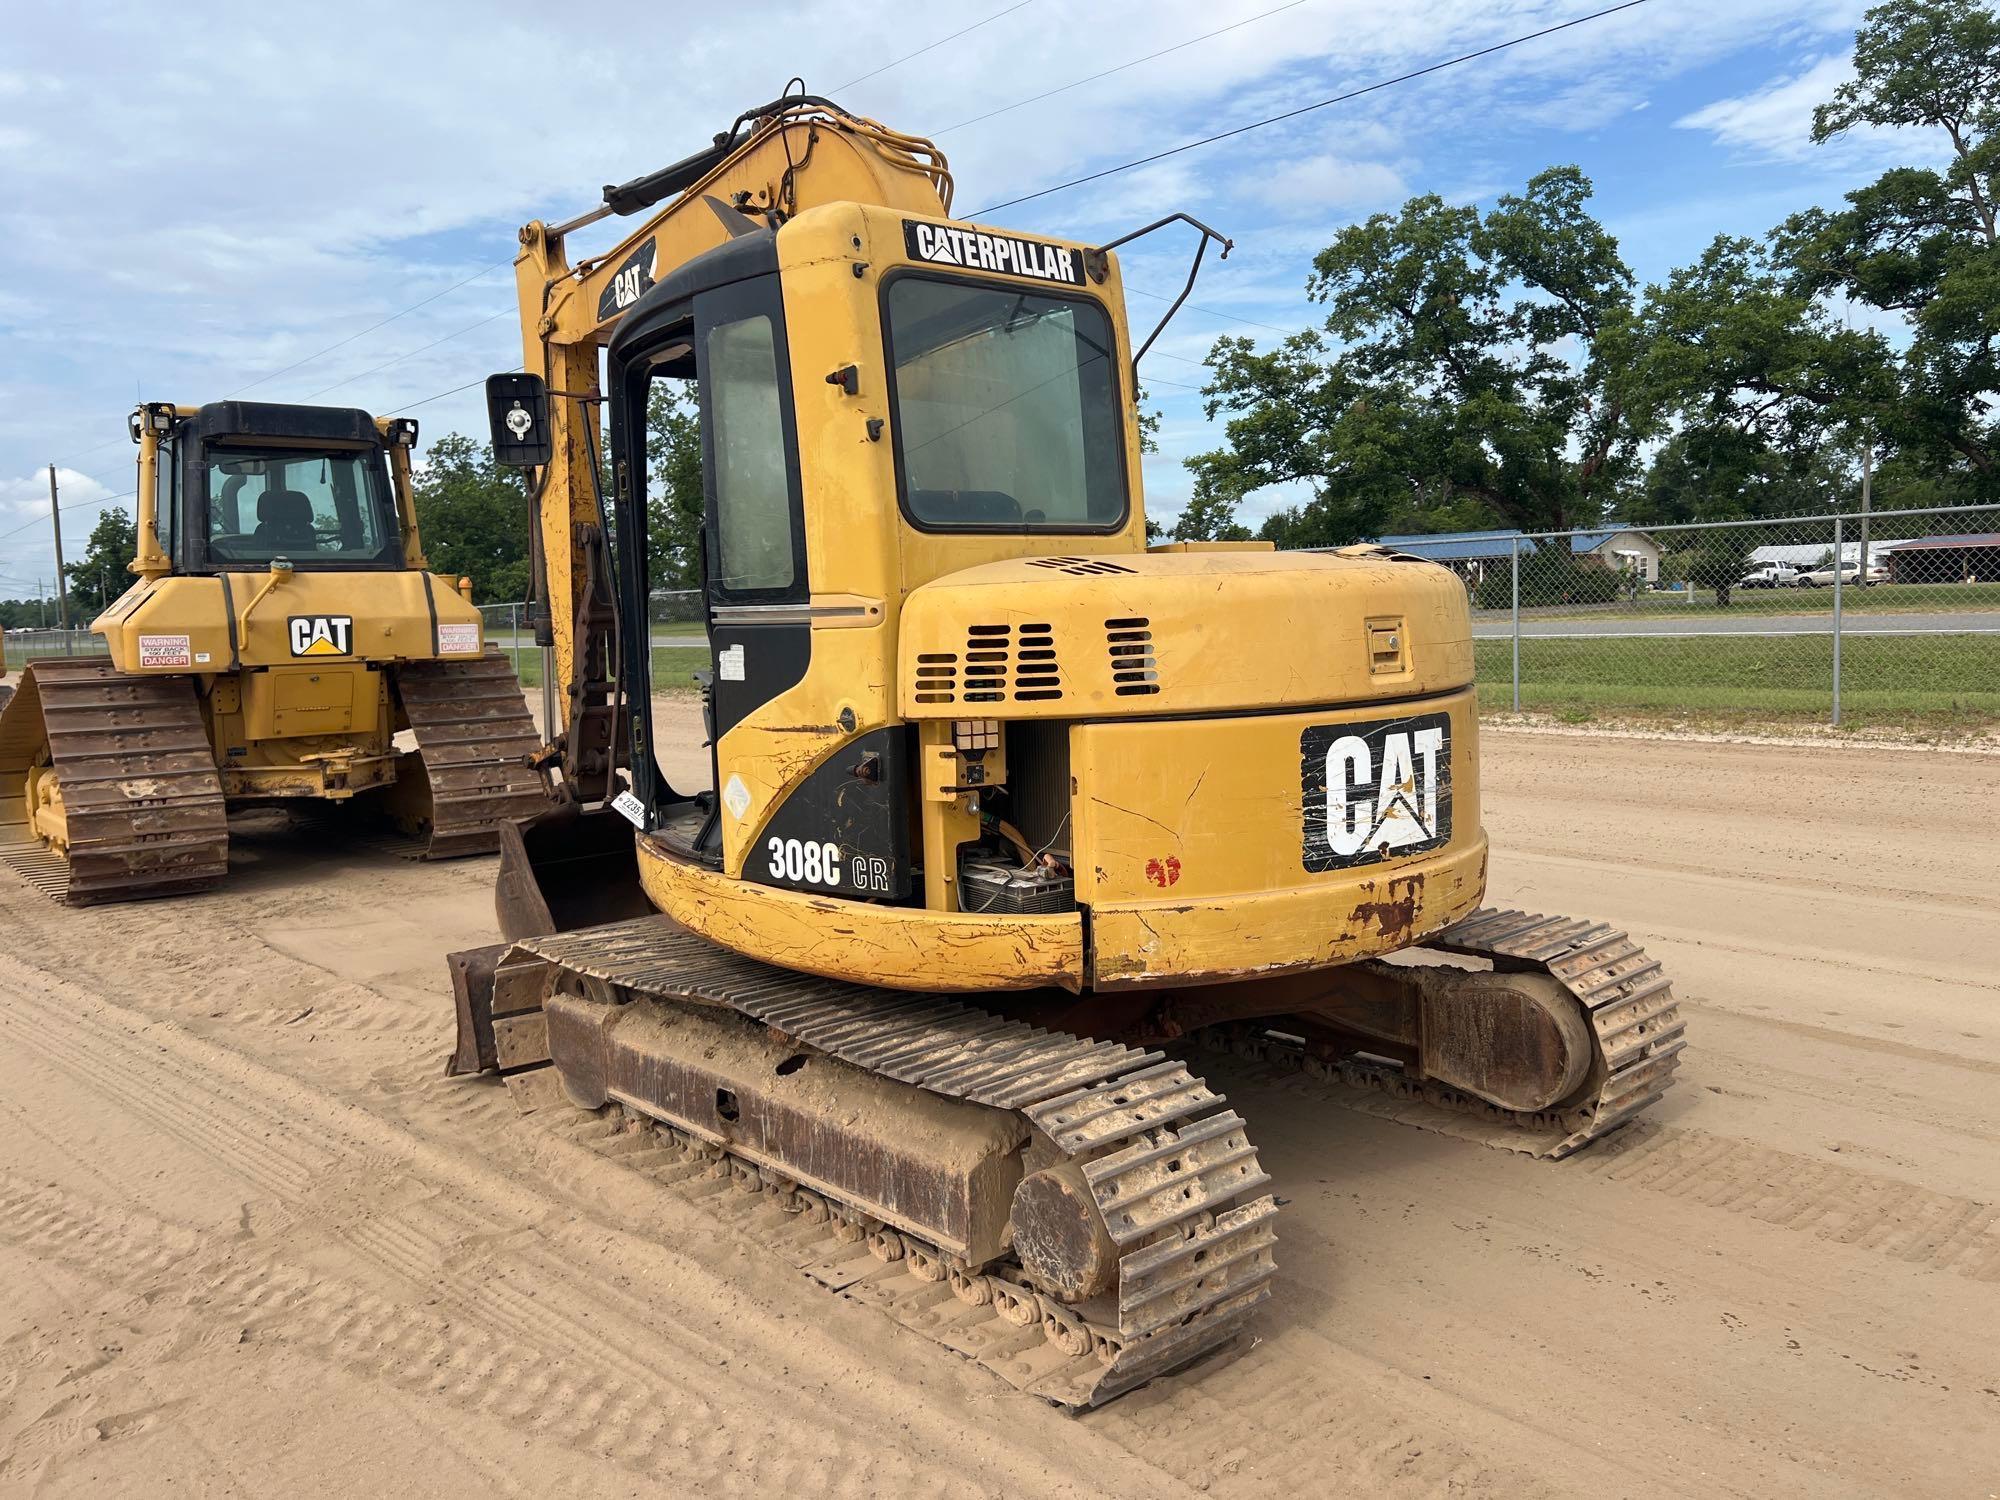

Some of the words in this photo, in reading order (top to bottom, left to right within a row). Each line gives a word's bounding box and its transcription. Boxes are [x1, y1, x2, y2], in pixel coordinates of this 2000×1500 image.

[916, 224, 1075, 283] CATERPILLAR
[614, 263, 640, 309] CAT
[143, 638, 187, 646] WARNING
[291, 618, 350, 655] CAT
[144, 657, 187, 665] DANGER
[1326, 727, 1442, 856] CAT
[768, 836, 840, 886] 308C
[852, 856, 889, 891] CR
